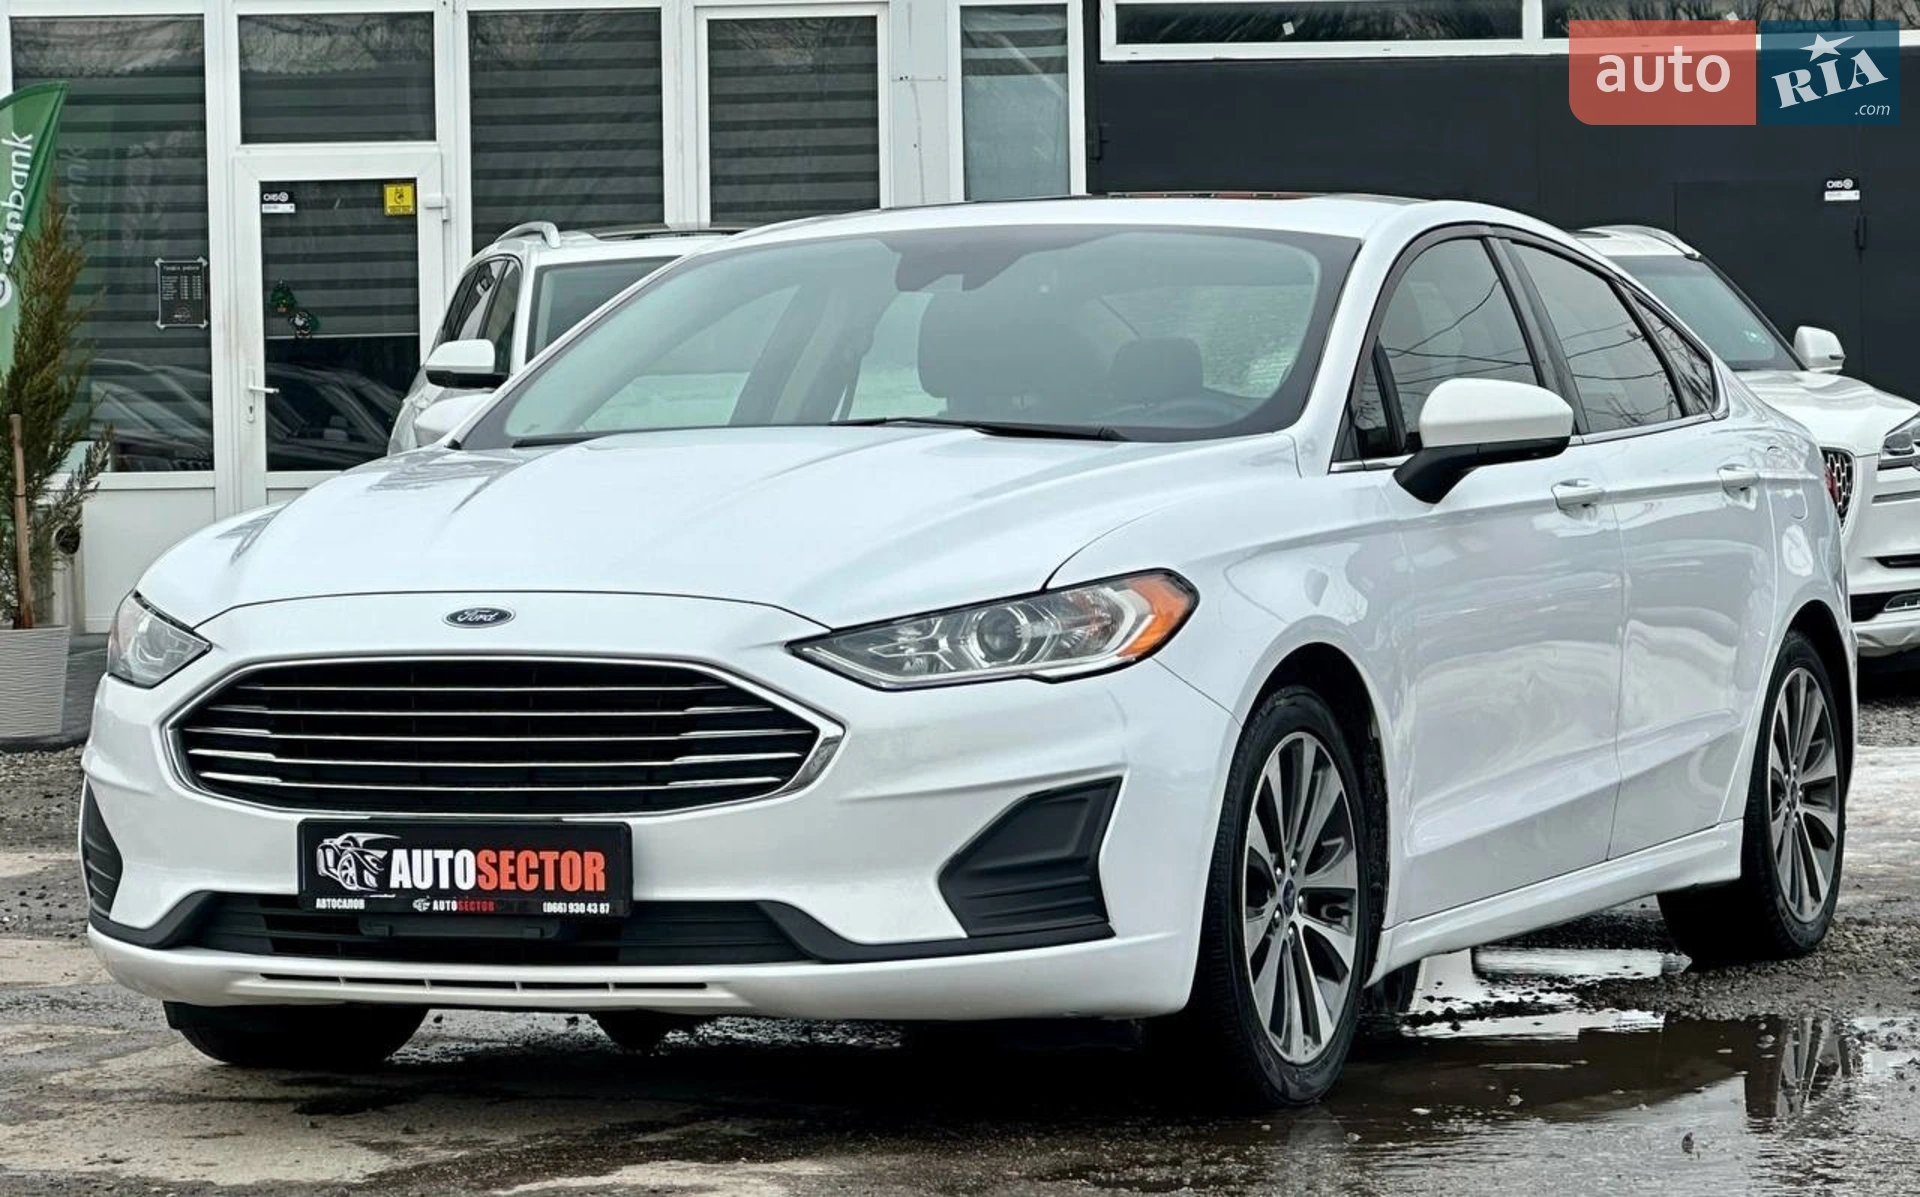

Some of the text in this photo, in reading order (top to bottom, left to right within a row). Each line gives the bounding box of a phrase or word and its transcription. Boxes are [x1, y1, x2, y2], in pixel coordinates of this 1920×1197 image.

[457, 610, 499, 622] Ford
[389, 848, 606, 892] AUTOSECTOR
[432, 900, 495, 912] AUTOSECTOR
[568, 902, 586, 914] 930
[586, 902, 598, 915] 43
